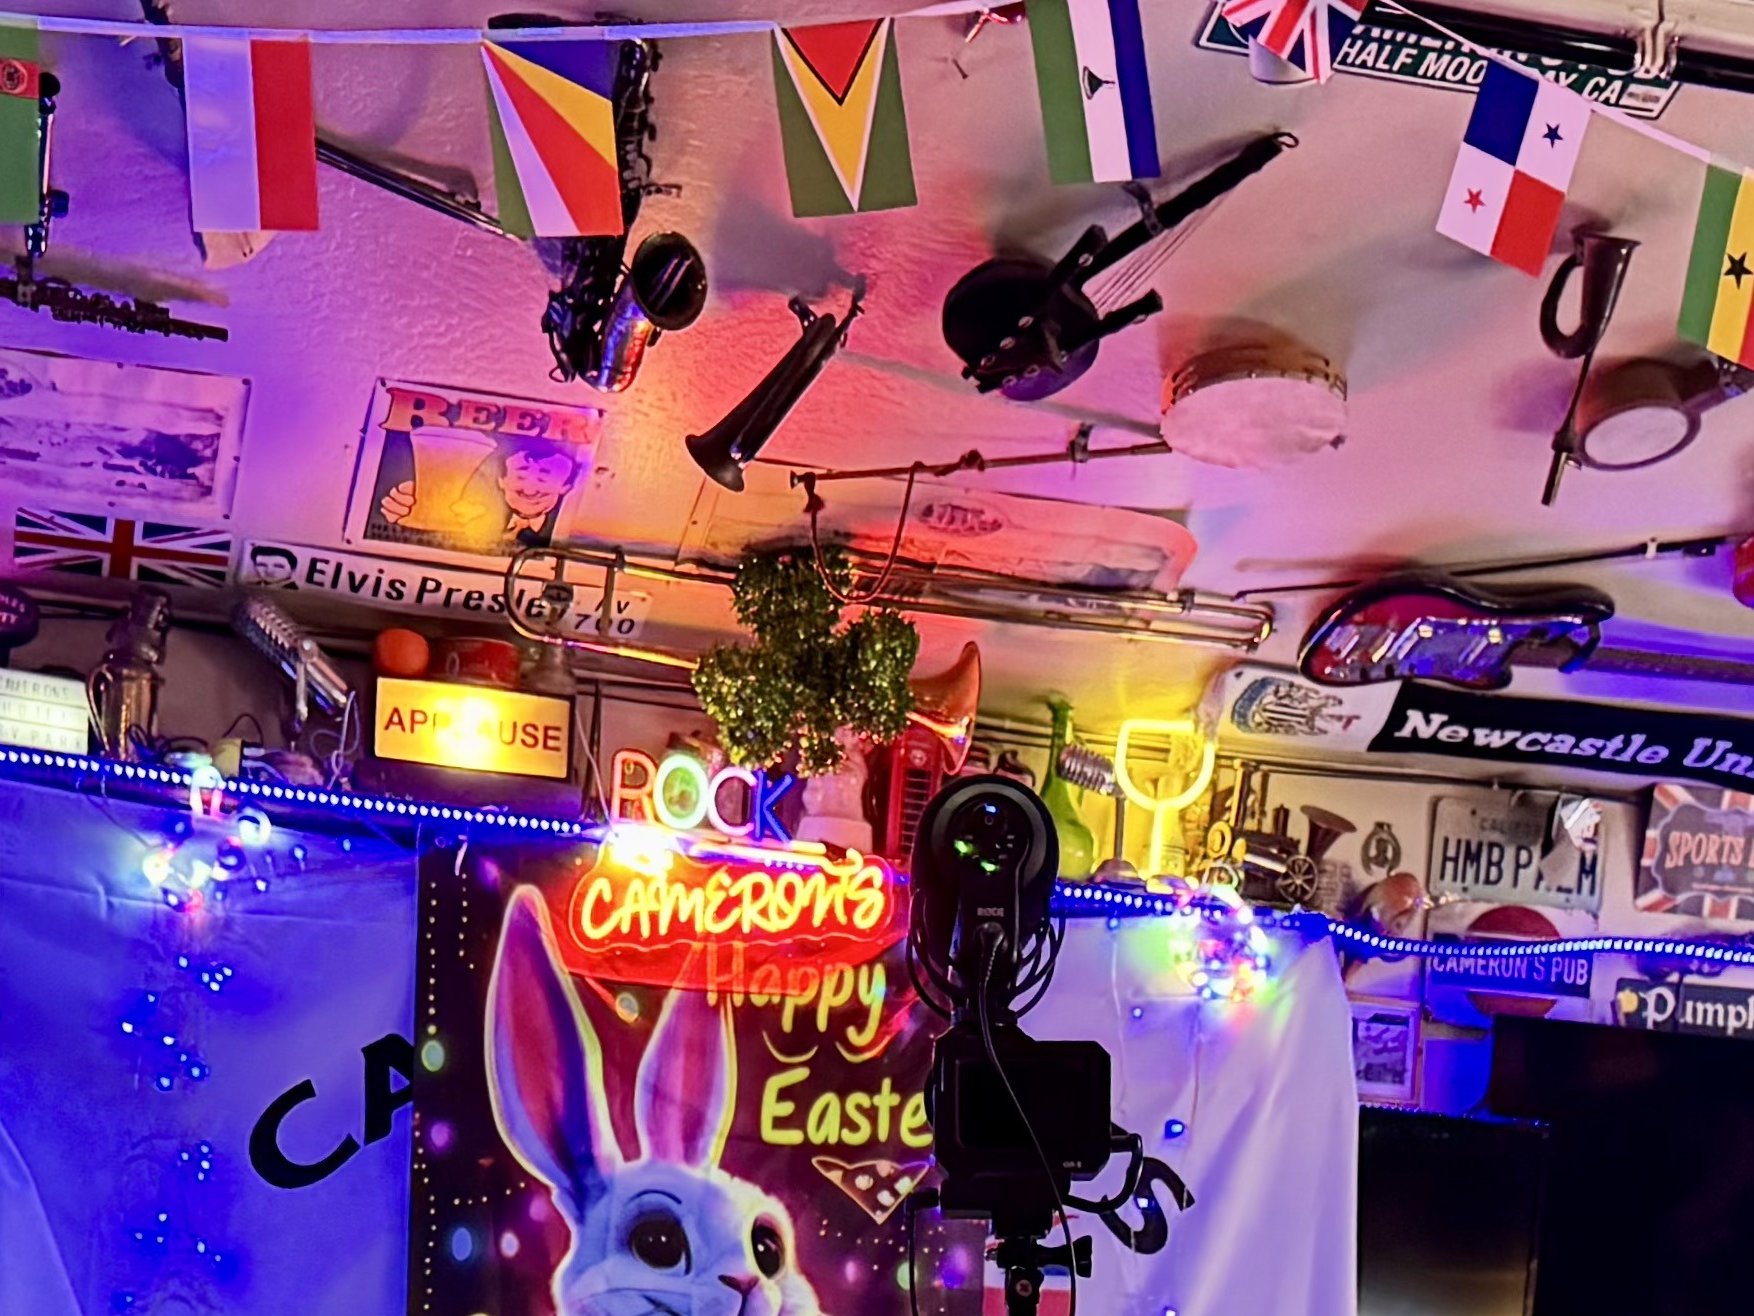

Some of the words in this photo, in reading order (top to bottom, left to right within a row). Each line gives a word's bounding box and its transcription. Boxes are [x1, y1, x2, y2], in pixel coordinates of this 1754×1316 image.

[1339, 38, 1417, 70] HALF
[1426, 45, 1485, 81] MOO
[1583, 74, 1623, 104] CA
[409, 387, 592, 446] BEER
[306, 556, 407, 603] Elvis
[1393, 708, 1670, 767] Newcastle
[611, 746, 796, 843] ROCK
[1439, 837, 1504, 888] HMB
[1664, 829, 1743, 868] SPORTS
[706, 939, 886, 1049] Happy
[1431, 950, 1546, 982] CAMERON'S
[1550, 955, 1590, 987] PUB
